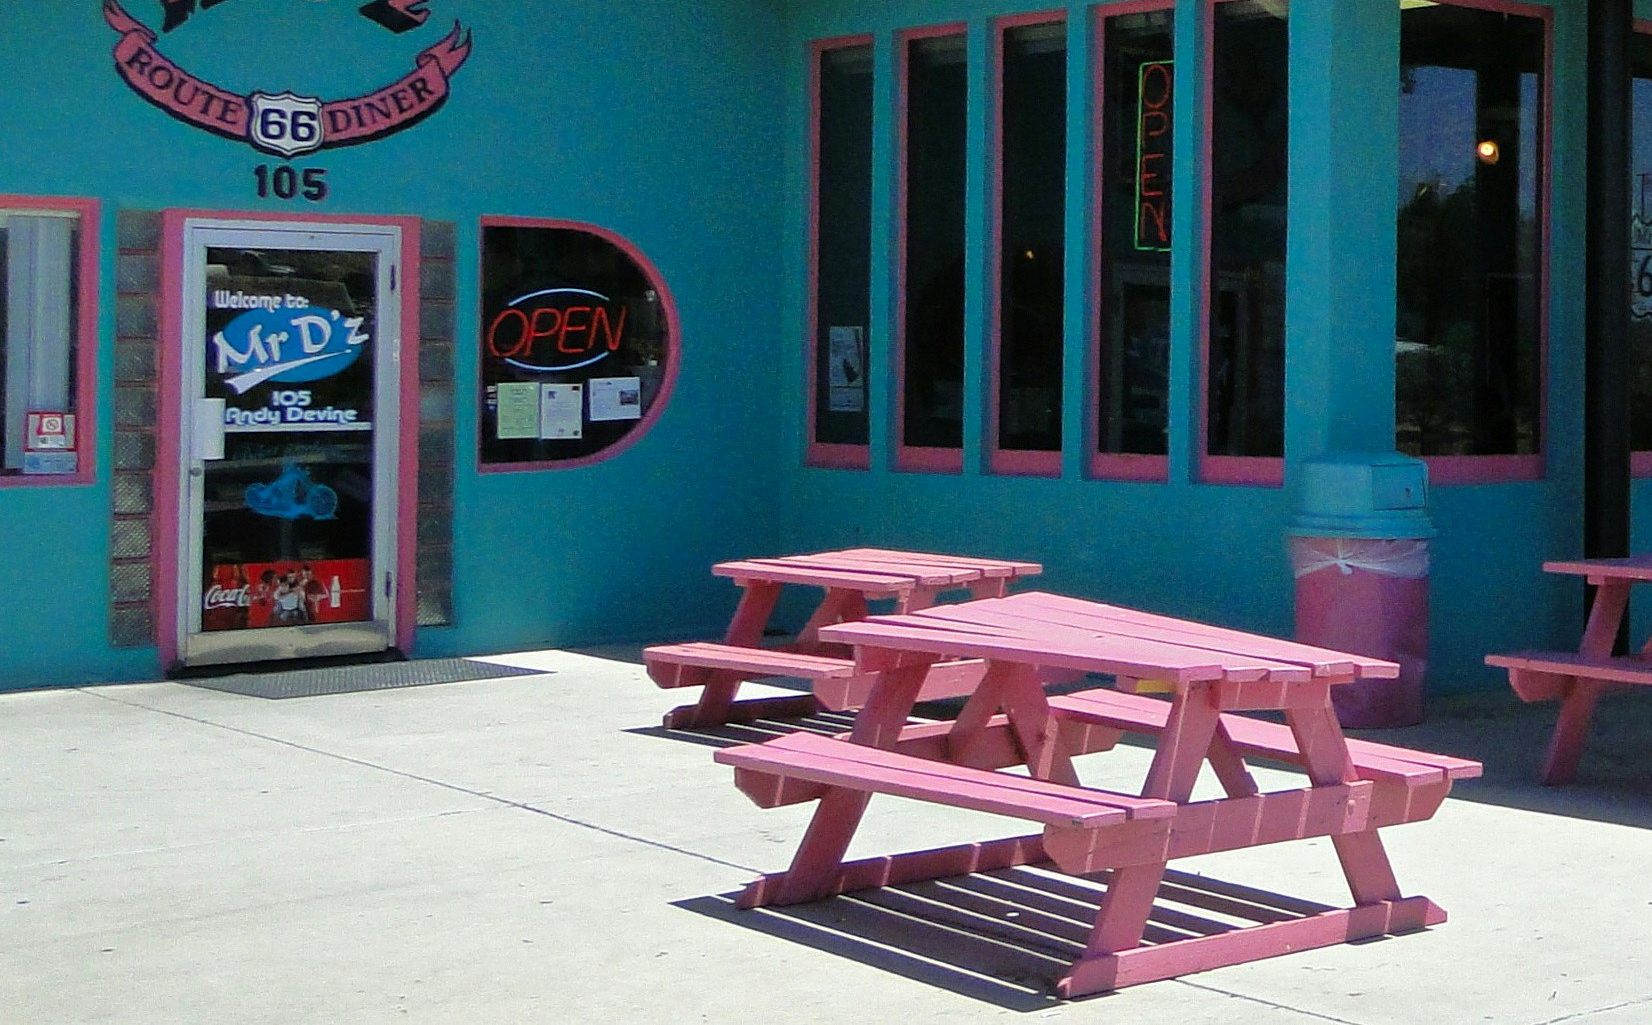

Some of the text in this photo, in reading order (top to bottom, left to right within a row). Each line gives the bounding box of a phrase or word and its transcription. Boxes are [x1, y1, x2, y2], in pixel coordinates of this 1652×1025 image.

[126, 46, 435, 142] ROUTE 66 DINER
[1140, 64, 1172, 242] OPEN
[253, 164, 330, 202] 105
[214, 289, 310, 313] Welcome to:
[213, 309, 370, 374] Mr D'z
[488, 305, 628, 358] OPEN
[226, 406, 358, 425] Andy Devine
[272, 390, 313, 406] 105
